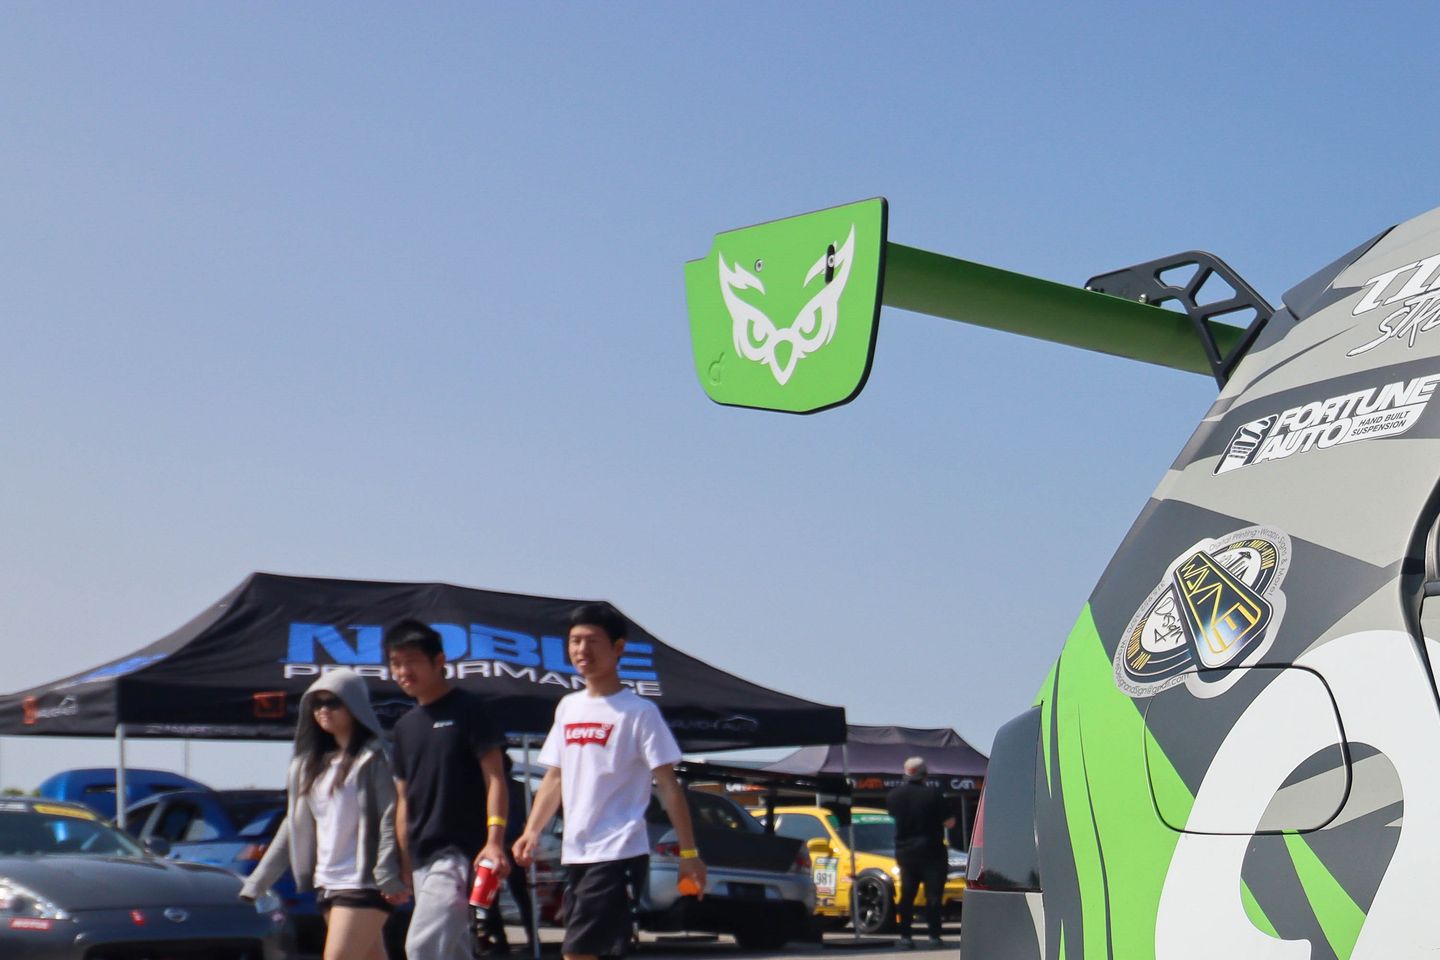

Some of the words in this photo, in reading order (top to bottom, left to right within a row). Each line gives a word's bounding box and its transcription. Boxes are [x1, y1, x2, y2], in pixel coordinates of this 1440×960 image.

[1358, 415, 1384, 427] HAND
[1384, 410, 1410, 422] BUILT
[1351, 419, 1407, 436] SUSPENSION
[1252, 417, 1353, 465] AUTO
